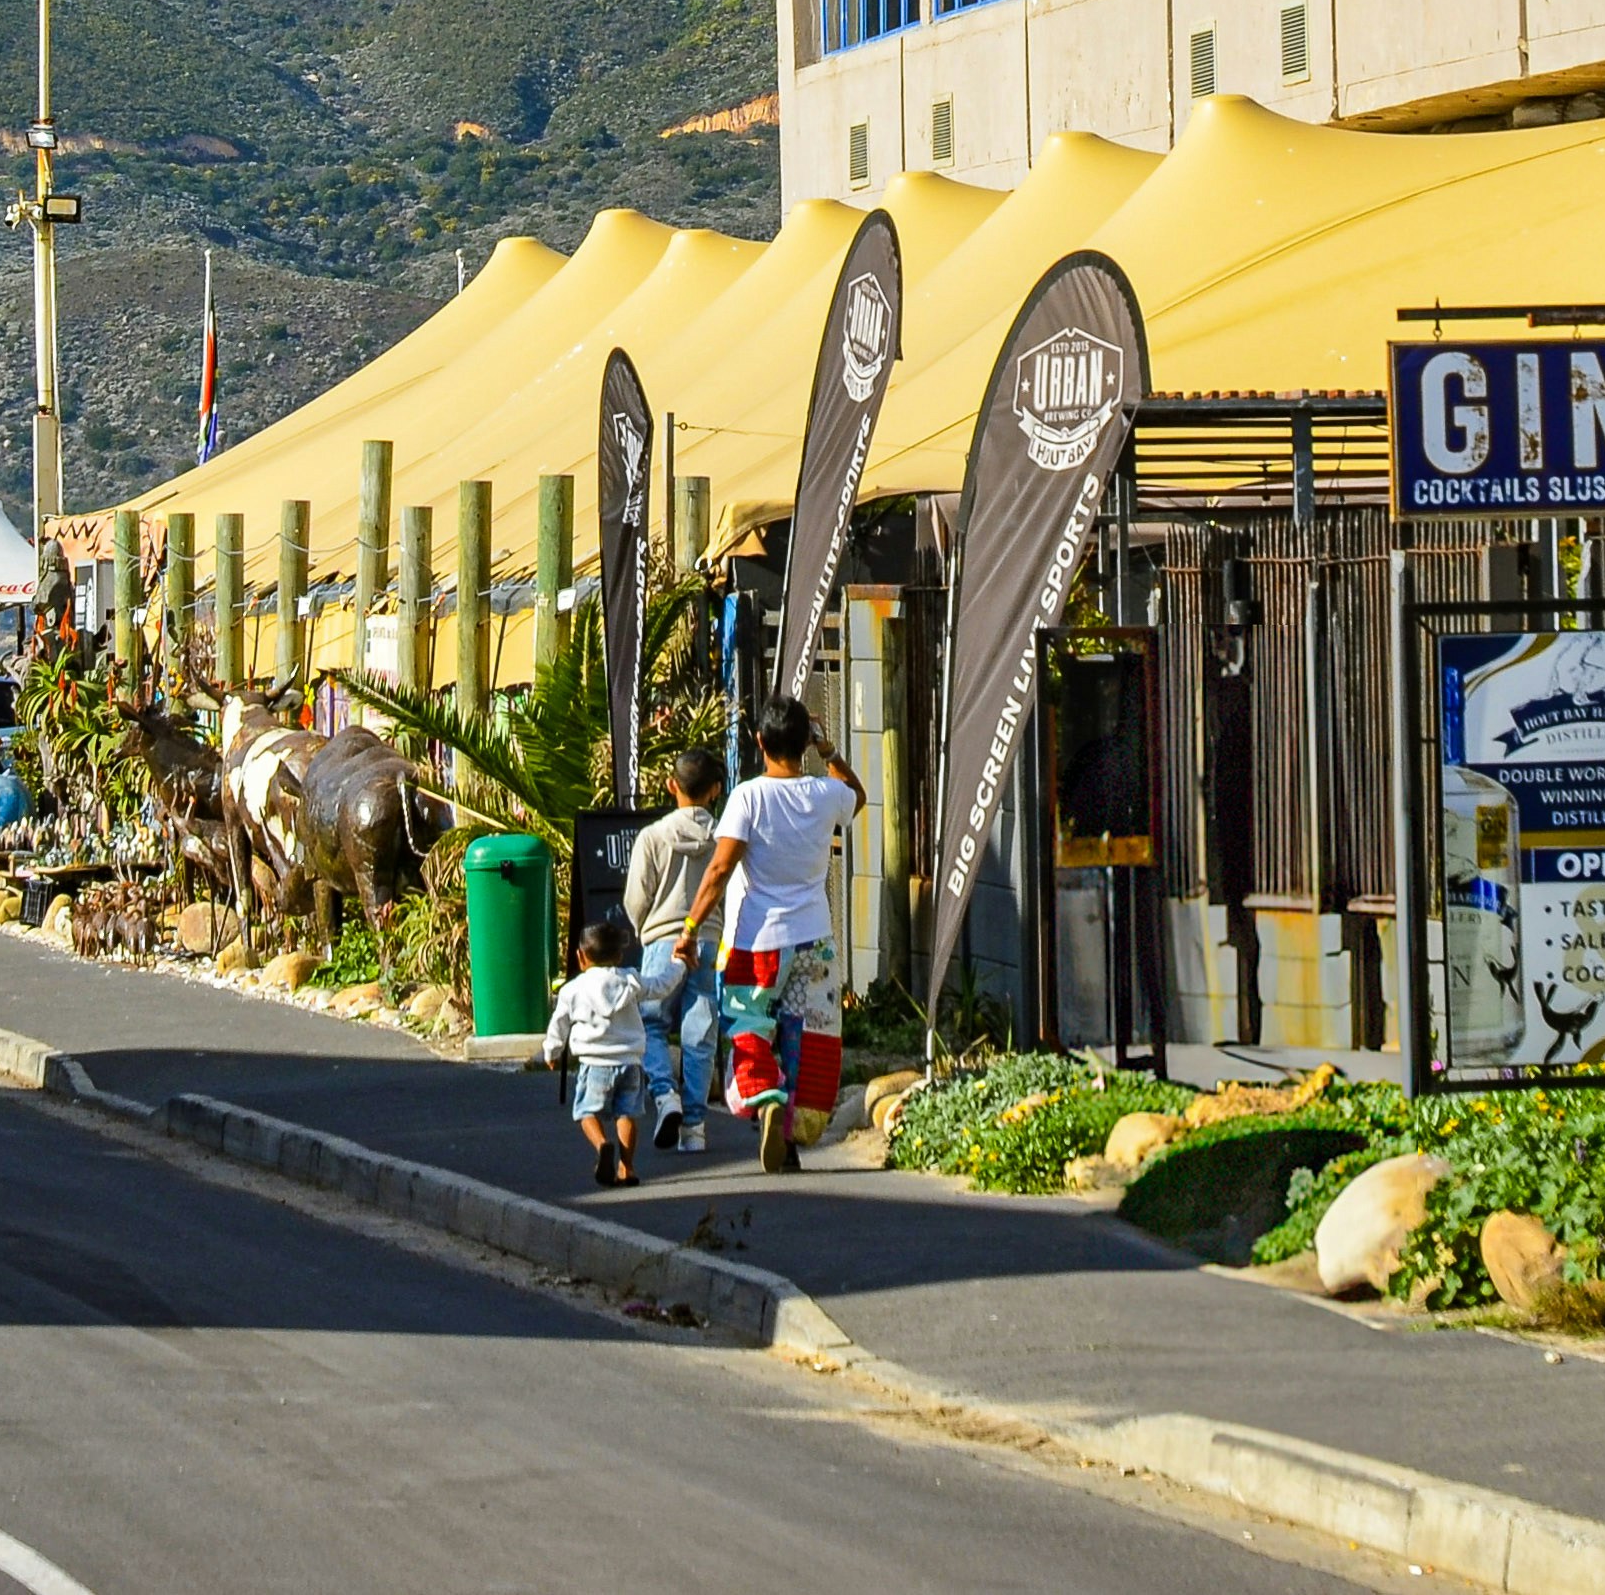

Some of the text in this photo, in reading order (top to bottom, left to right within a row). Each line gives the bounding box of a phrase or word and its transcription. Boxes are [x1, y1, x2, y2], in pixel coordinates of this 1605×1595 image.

[1034, 349, 1103, 411] URBAN
[1414, 477, 1540, 504] COCKTAILS
[948, 833, 976, 897] BIG
[969, 694, 1022, 832] SCREEN
[1040, 472, 1099, 615] SPORTS
[1523, 710, 1560, 731] HOUT
[1563, 707, 1589, 720] BAY
[1499, 768, 1564, 784] DOUBLE
